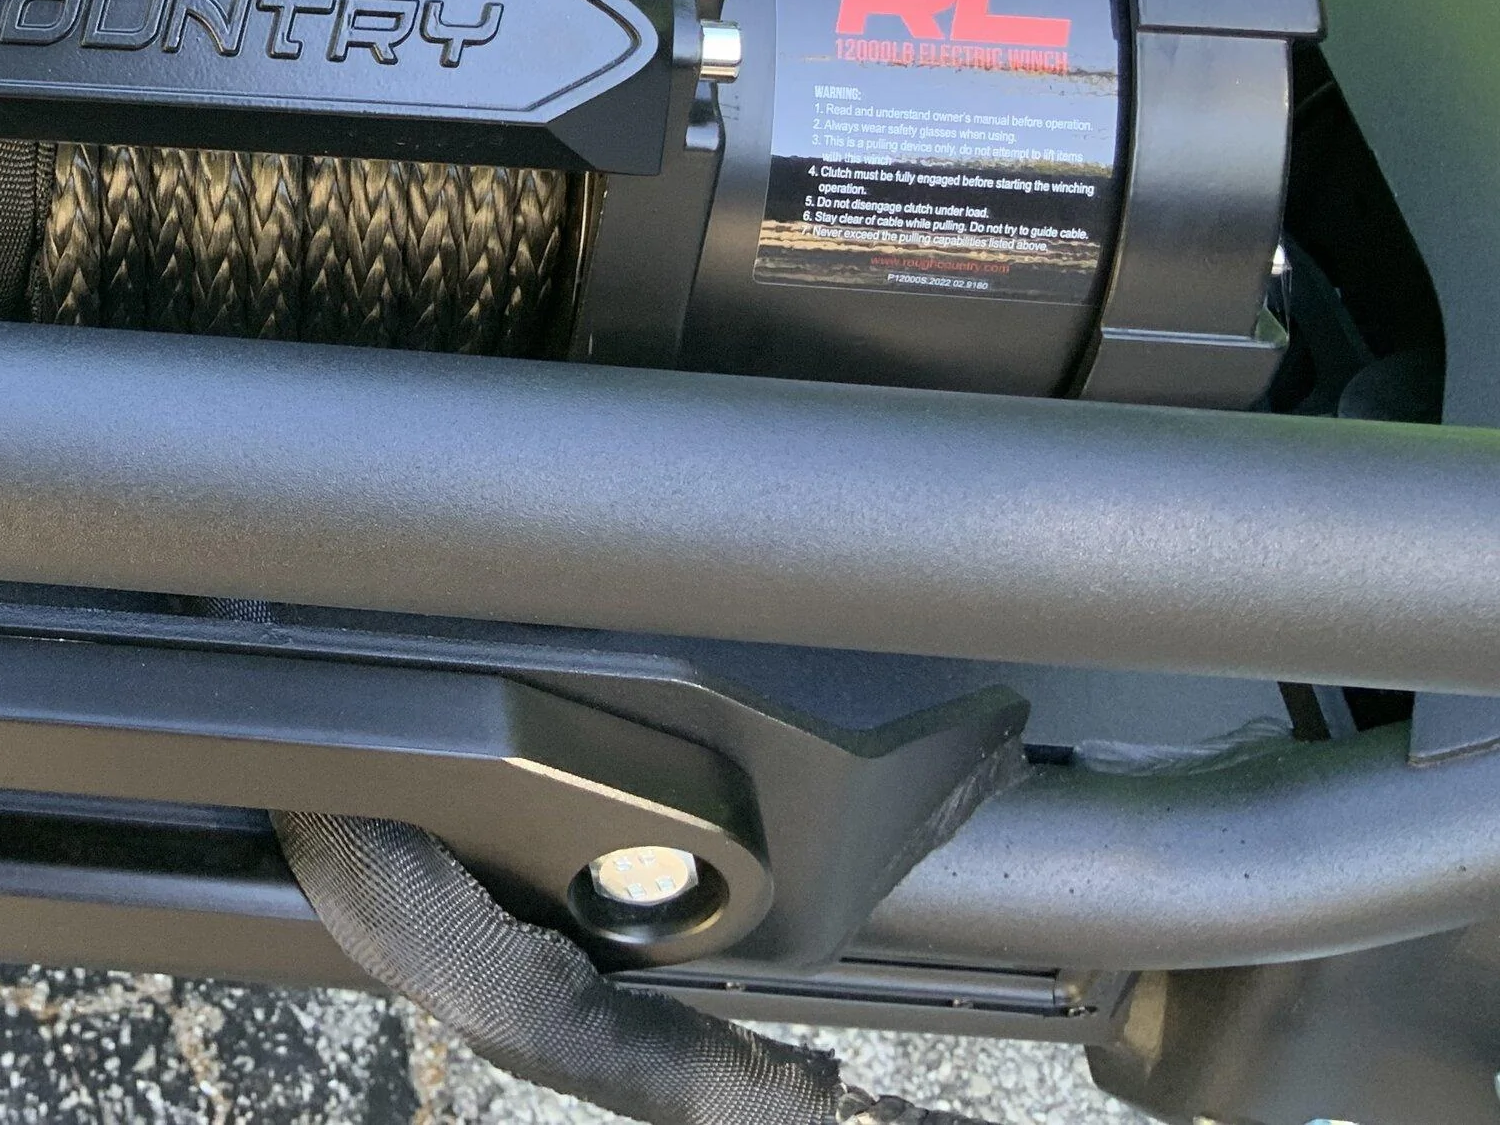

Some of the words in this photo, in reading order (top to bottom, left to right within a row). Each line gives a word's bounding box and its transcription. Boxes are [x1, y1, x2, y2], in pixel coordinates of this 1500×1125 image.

[836, 38, 914, 63] 12000LB
[919, 42, 1003, 68] ELECTRIC
[1008, 49, 1068, 74] WINCH
[814, 85, 861, 100] WARNING:
[814, 103, 824, 114] 1.
[826, 103, 852, 115] Read
[855, 106, 873, 117] and
[876, 108, 930, 121] understand
[933, 112, 971, 123] owner's
[974, 115, 1010, 126] manual
[1012, 116, 1043, 128] before
[1045, 118, 1093, 131] operation.
[813, 118, 823, 129] 2.
[824, 119, 859, 134] Always
[861, 124, 886, 134] wear
[888, 124, 918, 138] safety
[920, 128, 957, 139] glasses
[960, 129, 986, 140] when
[988, 132, 1017, 144] using.
[812, 134, 821, 145] 3.
[824, 135, 844, 147] This
[846, 137, 855, 147] is
[856, 140, 864, 148] a
[866, 138, 898, 152] pulling
[900, 140, 932, 152] device
[934, 142, 957, 156] only,
[960, 144, 972, 155] do
[974, 146, 992, 156] not
[993, 146, 1030, 161] attempt
[1032, 148, 1041, 159] to
[1043, 148, 1055, 160] lift
[1056, 150, 1084, 162] items
[822, 152, 841, 162] with
[845, 153, 860, 163] this
[808, 165, 818, 176] 4.
[821, 166, 852, 179] Clutch
[854, 169, 878, 180] must
[881, 170, 893, 181] be
[895, 171, 915, 185] fully
[917, 175, 960, 187] engaged
[962, 175, 994, 188] before
[996, 177, 1033, 192] starting
[1034, 180, 1050, 192] the
[1052, 181, 1094, 196] winching
[818, 183, 867, 195] operation.
[805, 196, 815, 207] 5.
[817, 196, 832, 208] Do
[833, 198, 850, 209] not
[851, 198, 902, 214] disengage
[904, 202, 933, 215] clutch
[935, 205, 964, 216] under
[965, 206, 989, 218] load.
[801, 225, 811, 236] 7.
[813, 226, 842, 238] Never
[844, 229, 879, 240] exceed
[881, 230, 898, 241] the
[899, 231, 931, 246] pulling
[933, 234, 987, 248] capabilities
[989, 237, 1015, 249] listed
[1016, 240, 1049, 251] above.
[803, 210, 812, 221] 6.
[815, 211, 837, 225] Stay
[839, 213, 863, 225] clear
[865, 215, 875, 225] of
[877, 216, 904, 227] cable
[906, 217, 931, 229] while
[933, 219, 967, 233] pulling.
[970, 221, 985, 233] Do
[986, 223, 1002, 234] not
[1004, 224, 1017, 237] try
[1019, 225, 1029, 235] to
[1030, 226, 1058, 238] guide
[1060, 228, 1089, 240] cable.
[870, 256, 1010, 273] www.roughcountry.com
